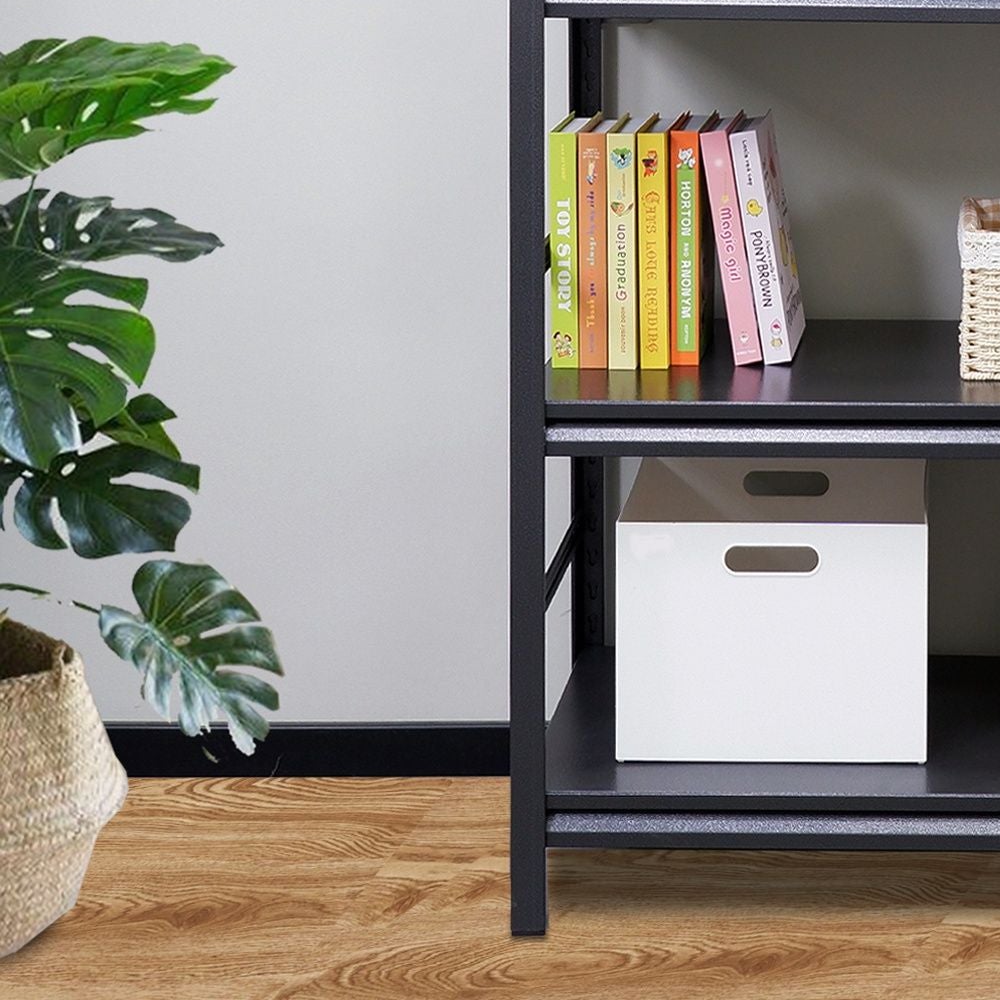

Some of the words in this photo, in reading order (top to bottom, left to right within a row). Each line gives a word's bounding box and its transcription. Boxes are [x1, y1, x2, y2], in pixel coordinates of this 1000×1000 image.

[556, 197, 571, 238] TOY
[681, 181, 692, 237] HORTON
[720, 207, 734, 253] Magic
[556, 245, 572, 313] STORY
[615, 224, 627, 302] Graduation
[680, 260, 692, 319] ANONYM
[725, 257, 741, 281] girl
[750, 230, 773, 307] PONYBROWN
